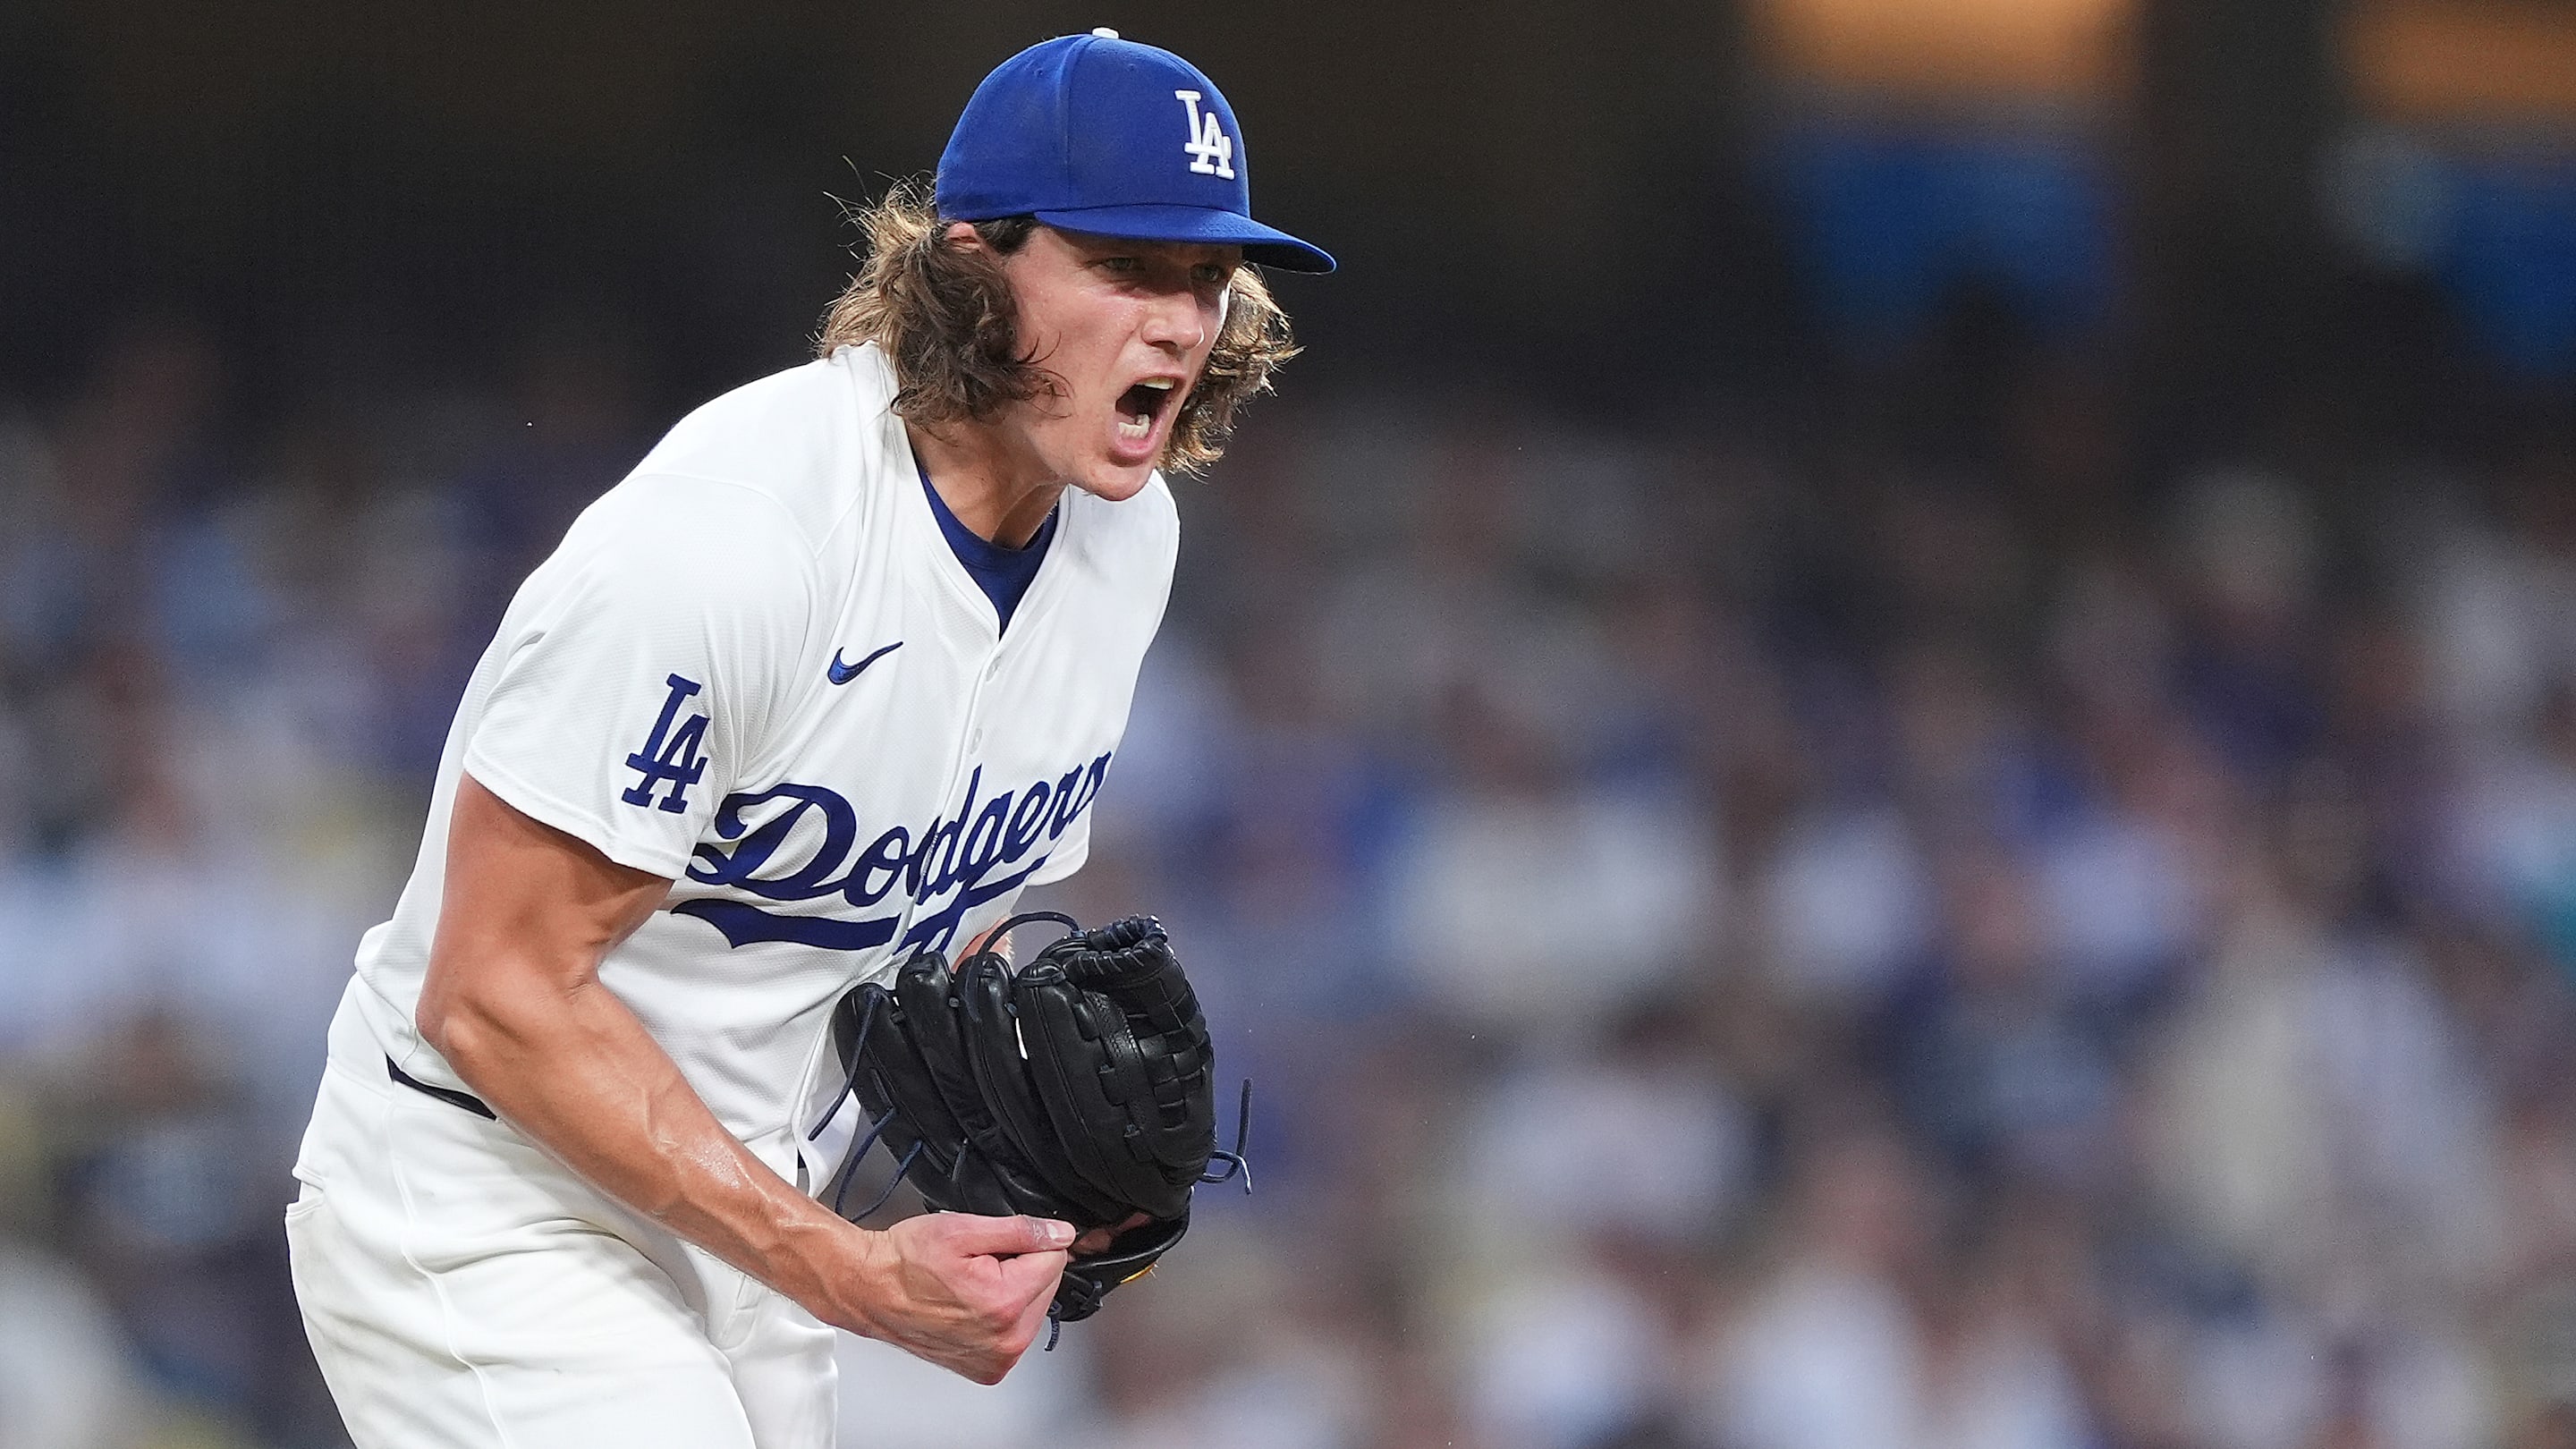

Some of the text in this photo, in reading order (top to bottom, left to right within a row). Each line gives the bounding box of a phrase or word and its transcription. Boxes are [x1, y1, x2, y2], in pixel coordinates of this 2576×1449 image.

[1174, 89, 1235, 180] LA
[621, 673, 710, 814] LA
[678, 750, 1112, 953] Dodgers
